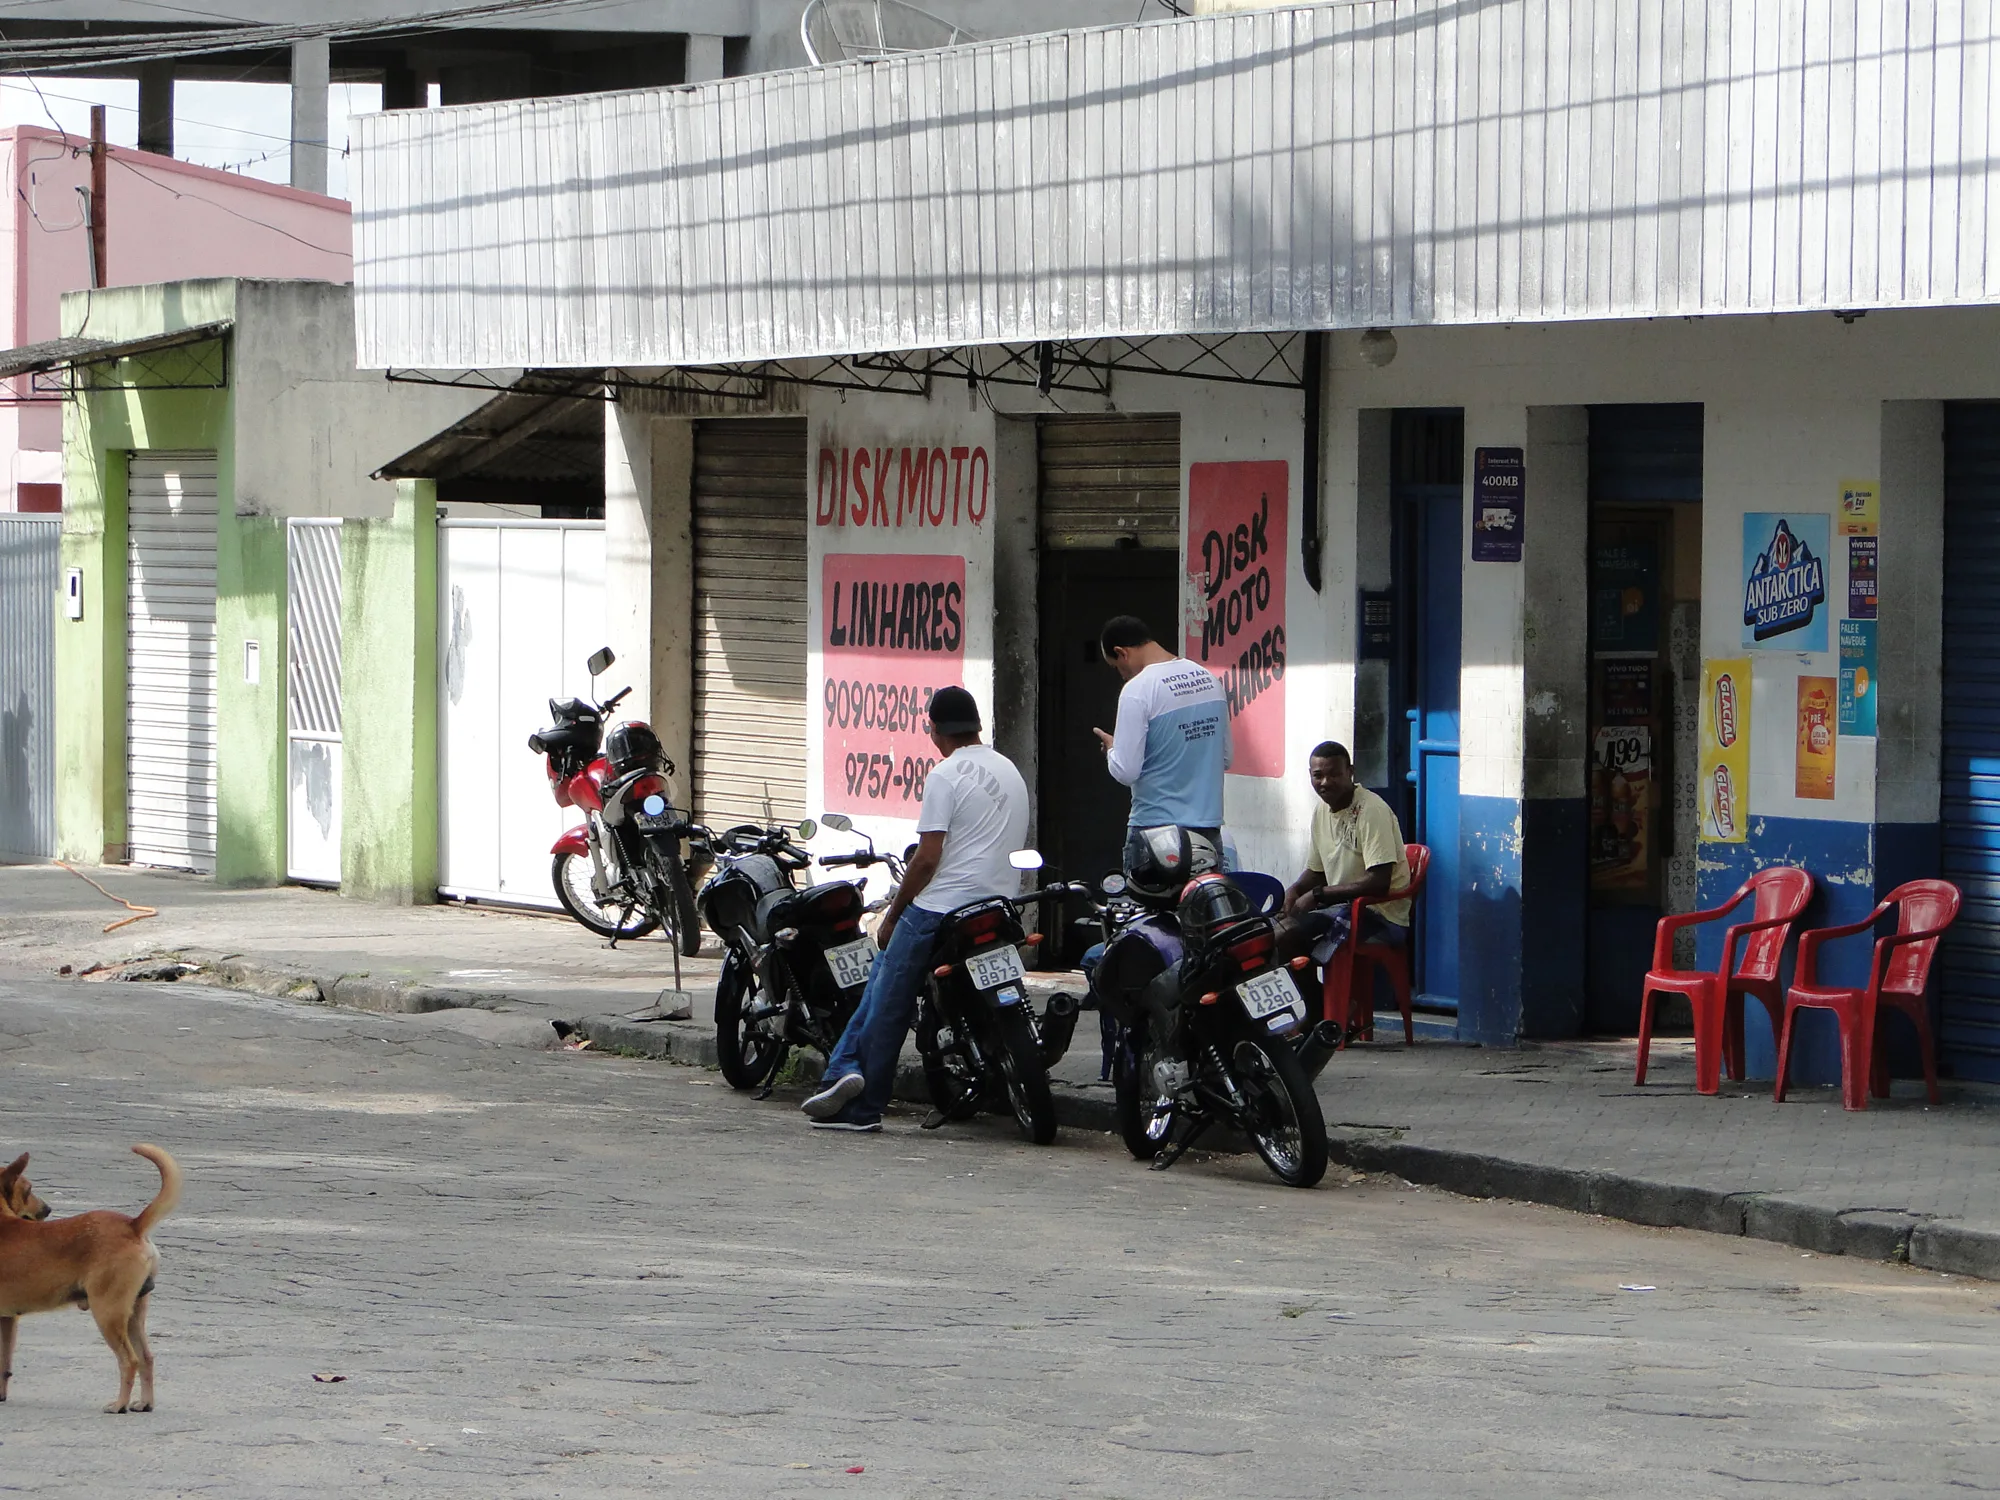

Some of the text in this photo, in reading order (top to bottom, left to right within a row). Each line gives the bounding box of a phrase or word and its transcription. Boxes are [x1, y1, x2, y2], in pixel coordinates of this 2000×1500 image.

[816, 446, 989, 527] DISK MOTO
[1482, 475, 1519, 487] 400MB
[1202, 492, 1268, 601] DISK
[1746, 561, 1820, 612] ANTARCTICA
[830, 581, 962, 652] LINHARES
[1202, 566, 1270, 661] MOTO
[1757, 596, 1809, 626] SUB ZERO
[1840, 623, 1860, 634] FALE E
[1840, 635, 1867, 646] NAVEGUE
[1161, 673, 1188, 684] MOTO
[1168, 677, 1212, 691] LINHARES
[1719, 680, 1735, 745] GLACIAL
[1716, 771, 1732, 835] GLACIAL
[977, 955, 1011, 975] OCY
[980, 965, 1019, 986] 8973
[1257, 990, 1295, 1013] 4290
